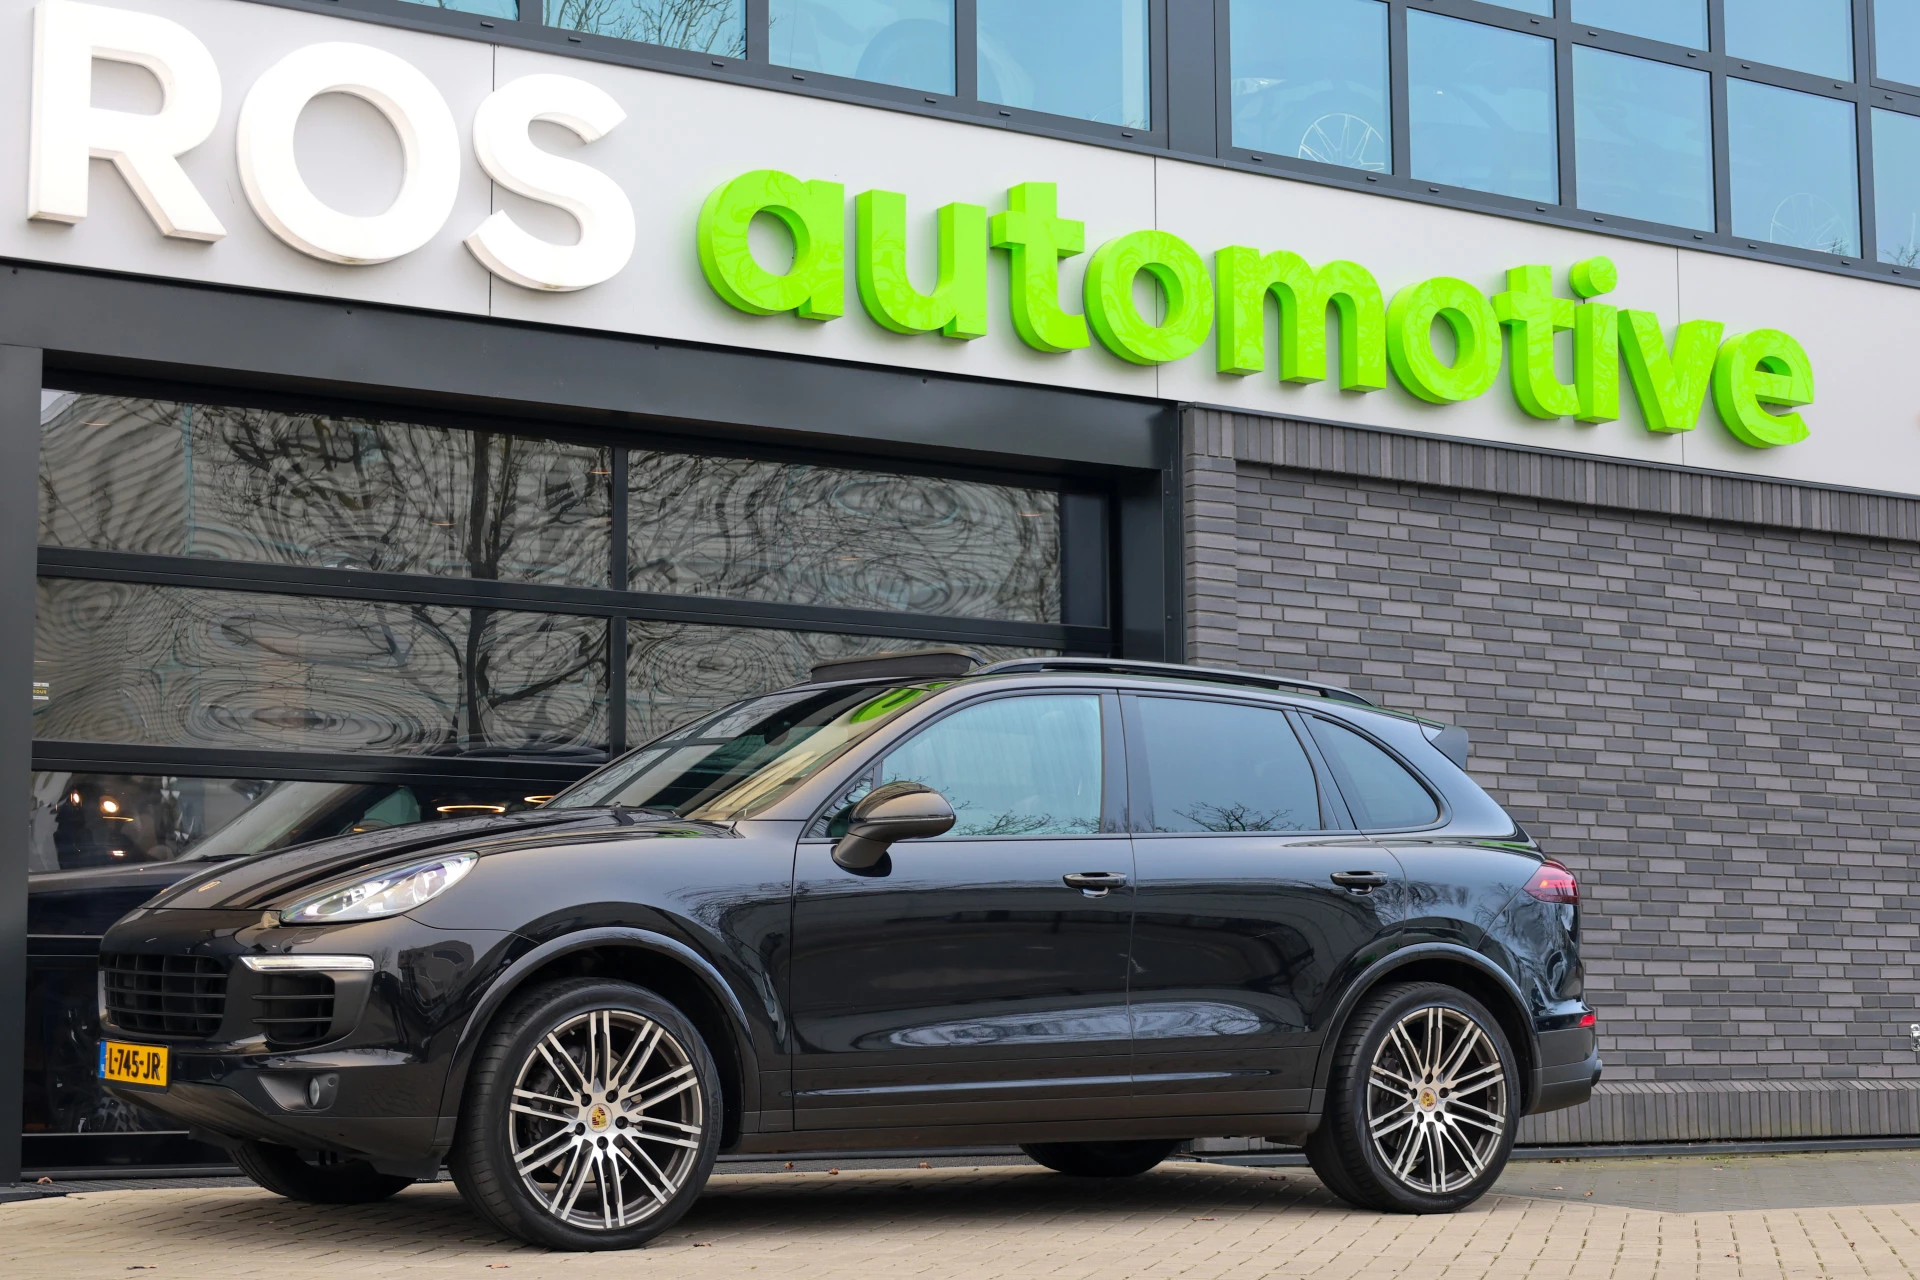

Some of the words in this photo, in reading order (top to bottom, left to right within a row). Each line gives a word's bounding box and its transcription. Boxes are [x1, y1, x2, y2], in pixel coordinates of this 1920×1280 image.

[27, 0, 636, 292] ROS
[696, 169, 1814, 449] automotive
[108, 1047, 161, 1081] L-745-JR
